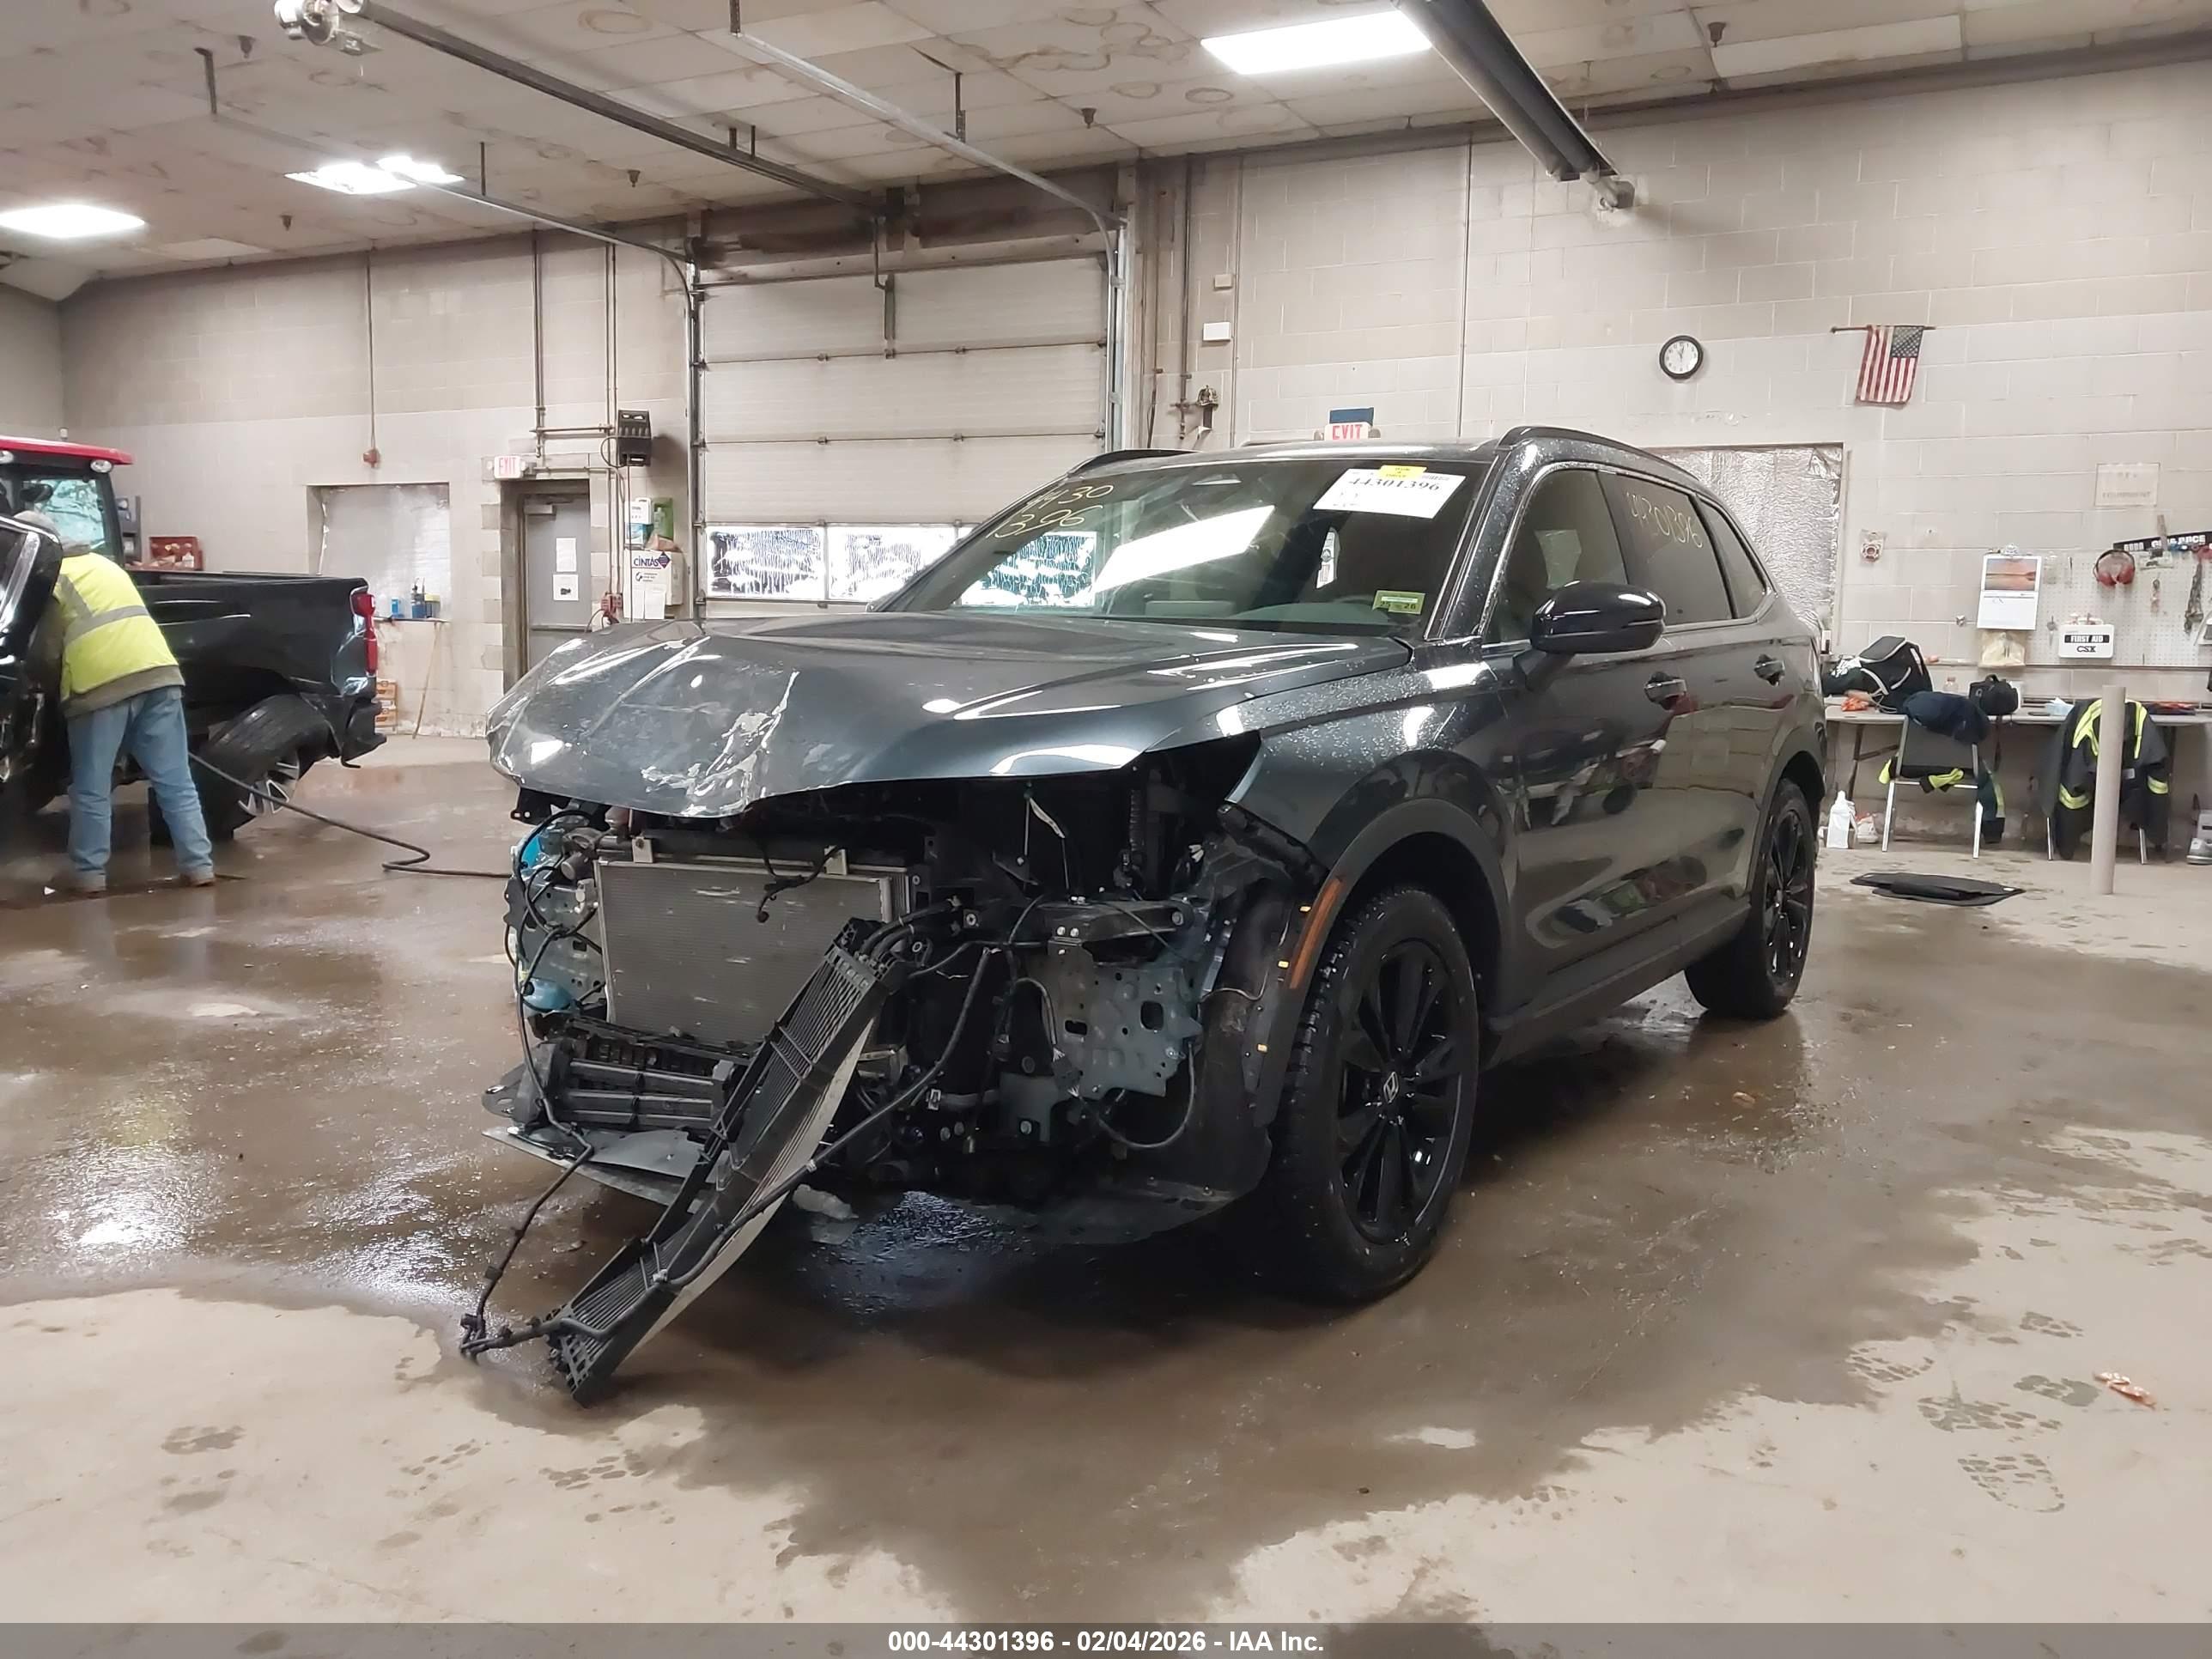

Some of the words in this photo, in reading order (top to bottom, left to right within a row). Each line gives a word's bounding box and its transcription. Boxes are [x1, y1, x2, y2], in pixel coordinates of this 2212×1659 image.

[498, 457, 517, 475] EXIT
[1349, 477, 1440, 491] 44301396
[2070, 635, 2089, 643] FIRST
[2076, 645, 2097, 653] CSX
